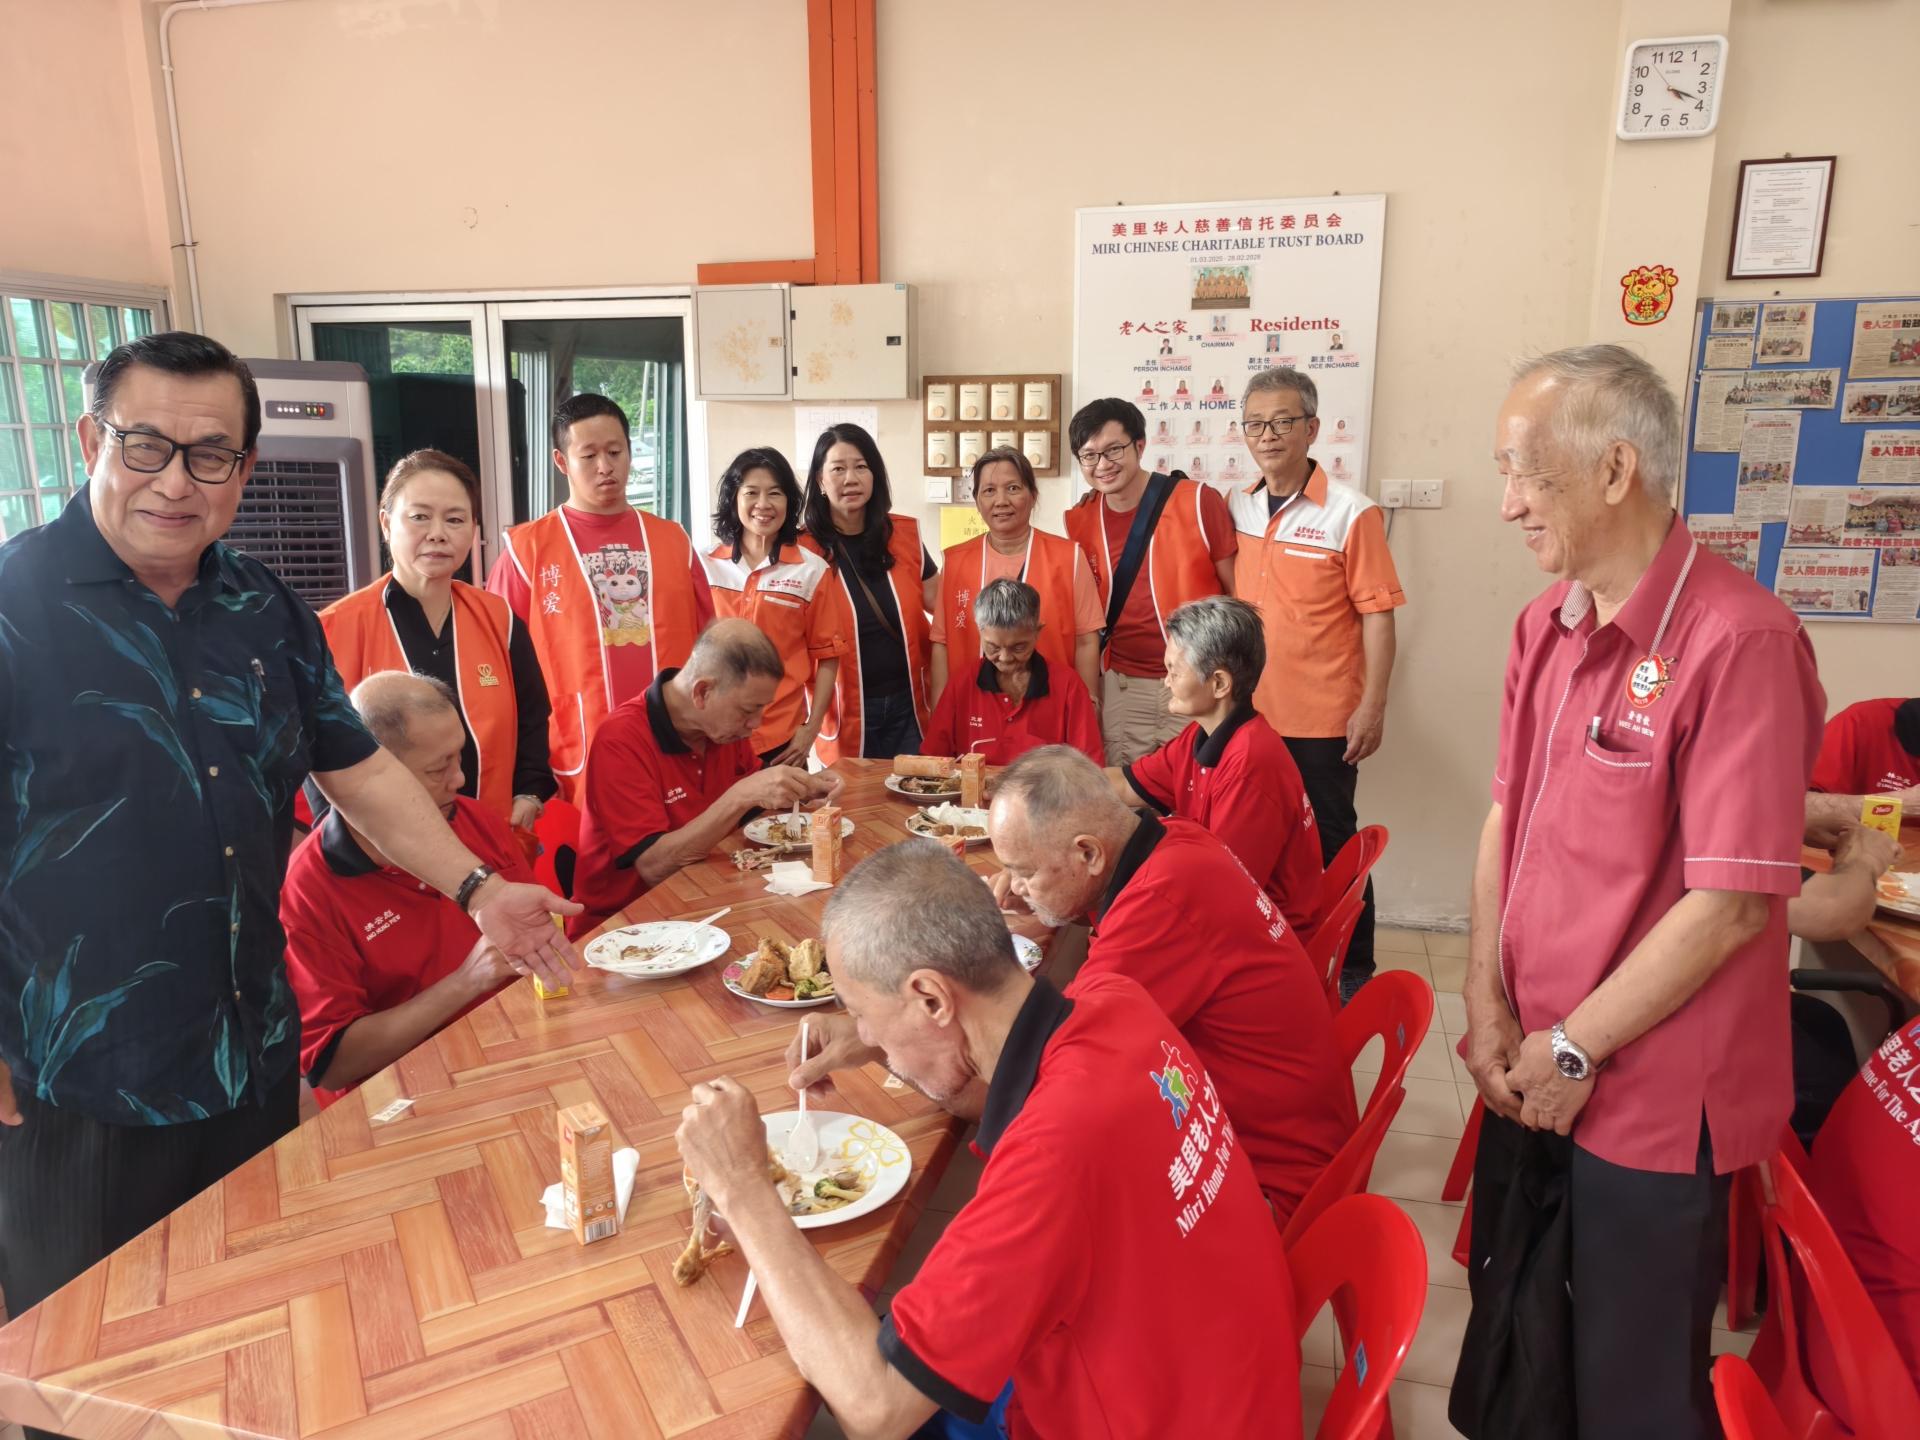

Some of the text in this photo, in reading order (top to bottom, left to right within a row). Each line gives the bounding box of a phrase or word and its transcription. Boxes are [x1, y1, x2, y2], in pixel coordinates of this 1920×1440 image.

[1652, 52, 1664, 64] 11
[1668, 50, 1684, 63] 12
[1692, 50, 1698, 62] 1
[1635, 66, 1649, 79] 10
[1700, 63, 1710, 75] 2
[1634, 84, 1644, 97] 9
[1697, 81, 1707, 94] 3
[1631, 102, 1641, 115] 8
[1694, 99, 1704, 112] 4
[1643, 115, 1653, 127] 7
[1660, 114, 1670, 127] 6
[1679, 113, 1689, 126] 5
[1112, 212, 1342, 237] 美里华人慈善信托委员会
[1092, 233, 1364, 255] MIRI CHINESE CHARITABLE TRUST BOARD
[1119, 320, 1189, 336] 老人之家
[1250, 316, 1340, 333] Residents
[1147, 401, 1192, 410] 工作人员
[1199, 400, 1236, 410] HOME
[539, 564, 564, 615] 博爱
[956, 589, 970, 628] 博爱
[1885, 1094, 1908, 1123] The
[1175, 1194, 1205, 1239] Miri
[1201, 1164, 1226, 1207] Home
[1215, 1142, 1231, 1170] For
